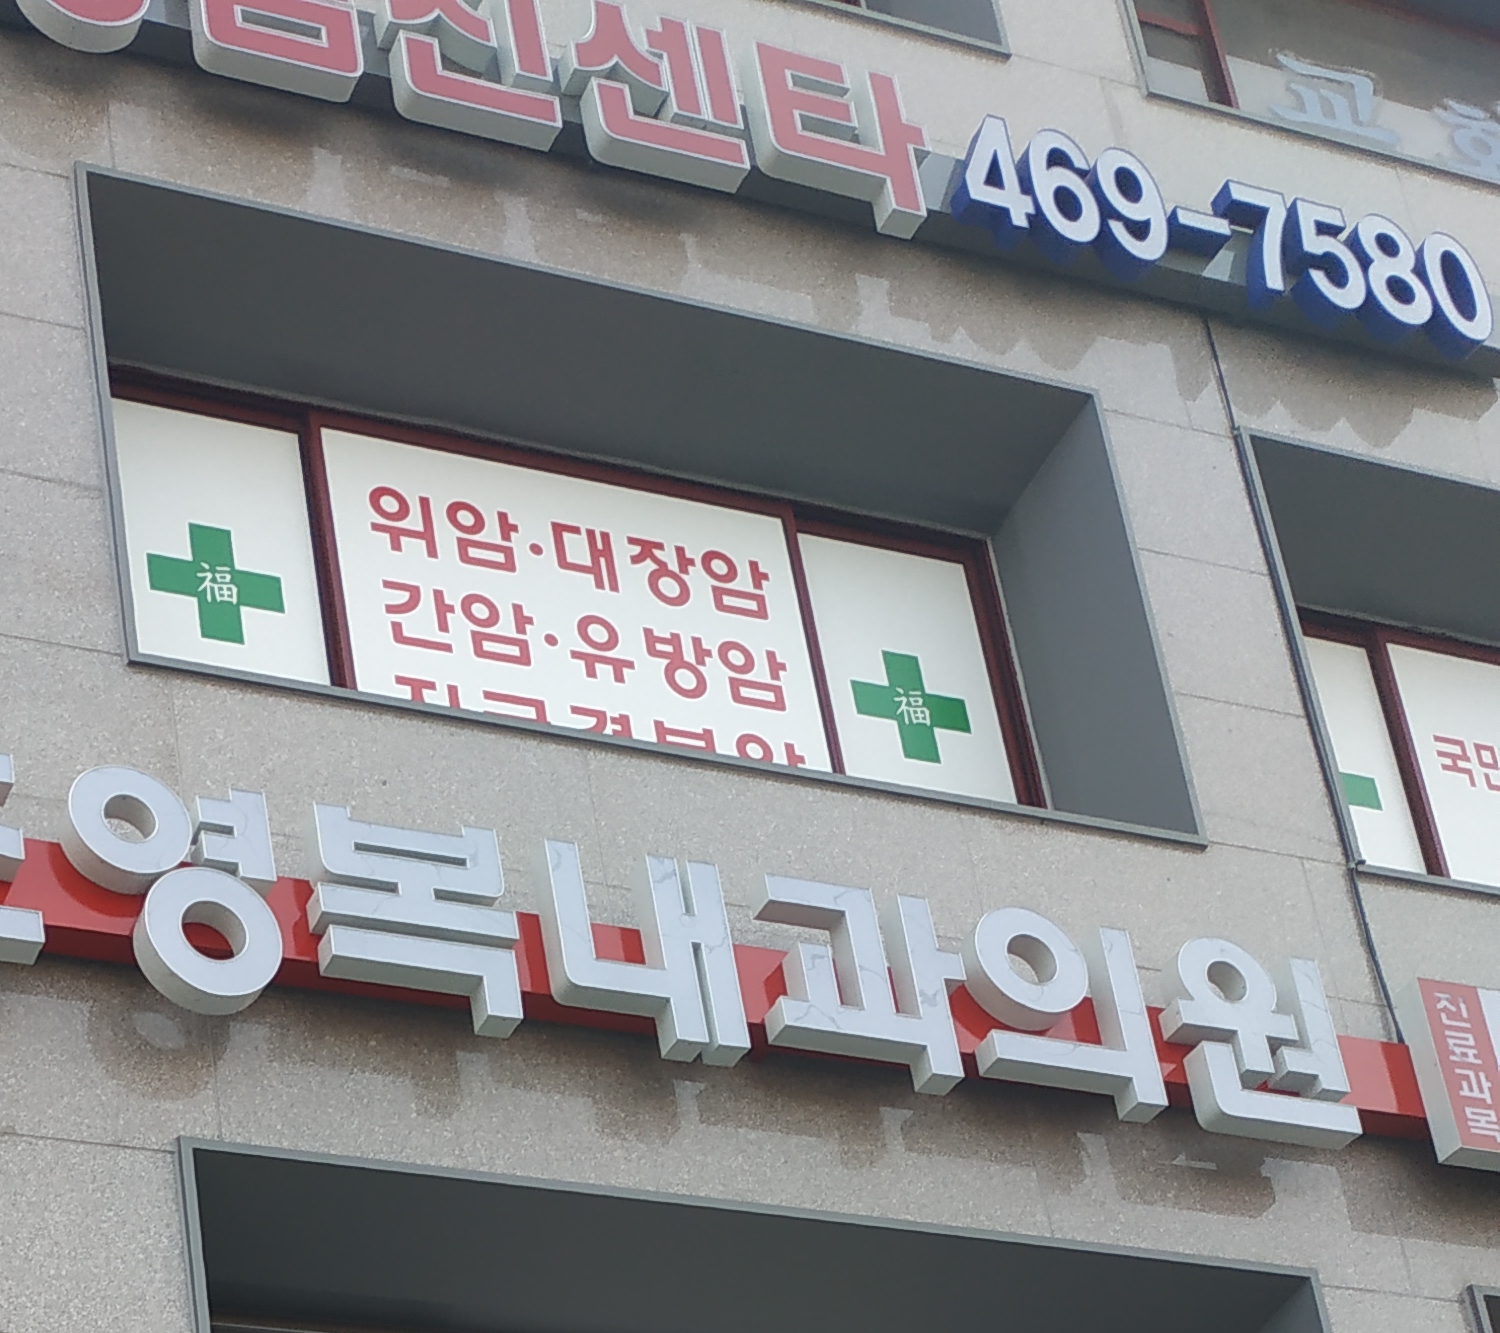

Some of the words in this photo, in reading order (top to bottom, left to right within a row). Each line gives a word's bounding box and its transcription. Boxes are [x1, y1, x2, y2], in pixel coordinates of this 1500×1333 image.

[955, 114, 1495, 350] 469-7580
[196, 560, 240, 609] 福
[893, 688, 931, 728] 福
